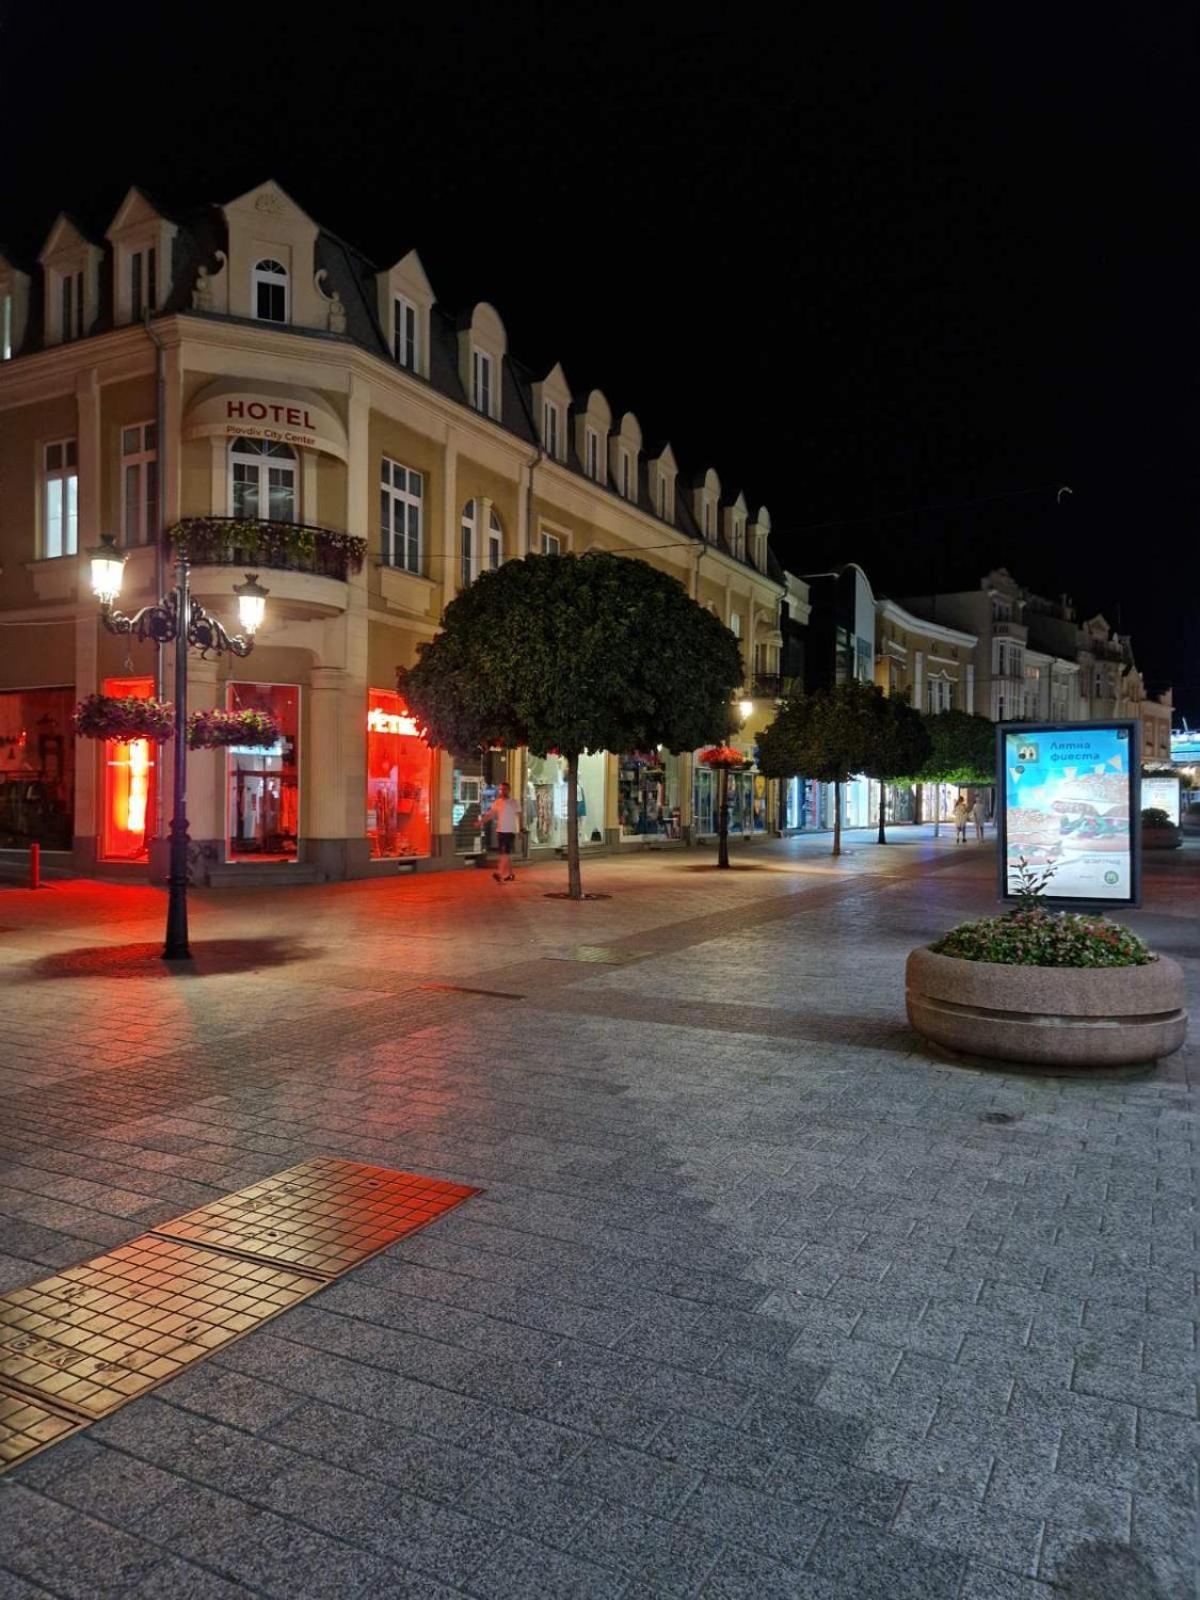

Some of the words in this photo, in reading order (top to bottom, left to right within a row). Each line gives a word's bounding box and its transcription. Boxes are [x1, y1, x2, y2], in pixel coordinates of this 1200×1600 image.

[227, 401, 316, 430] HOTEL
[226, 425, 261, 436] Plovdiv
[264, 429, 283, 440] City
[285, 432, 316, 445] Center
[1050, 752, 1100, 762] фиеста
